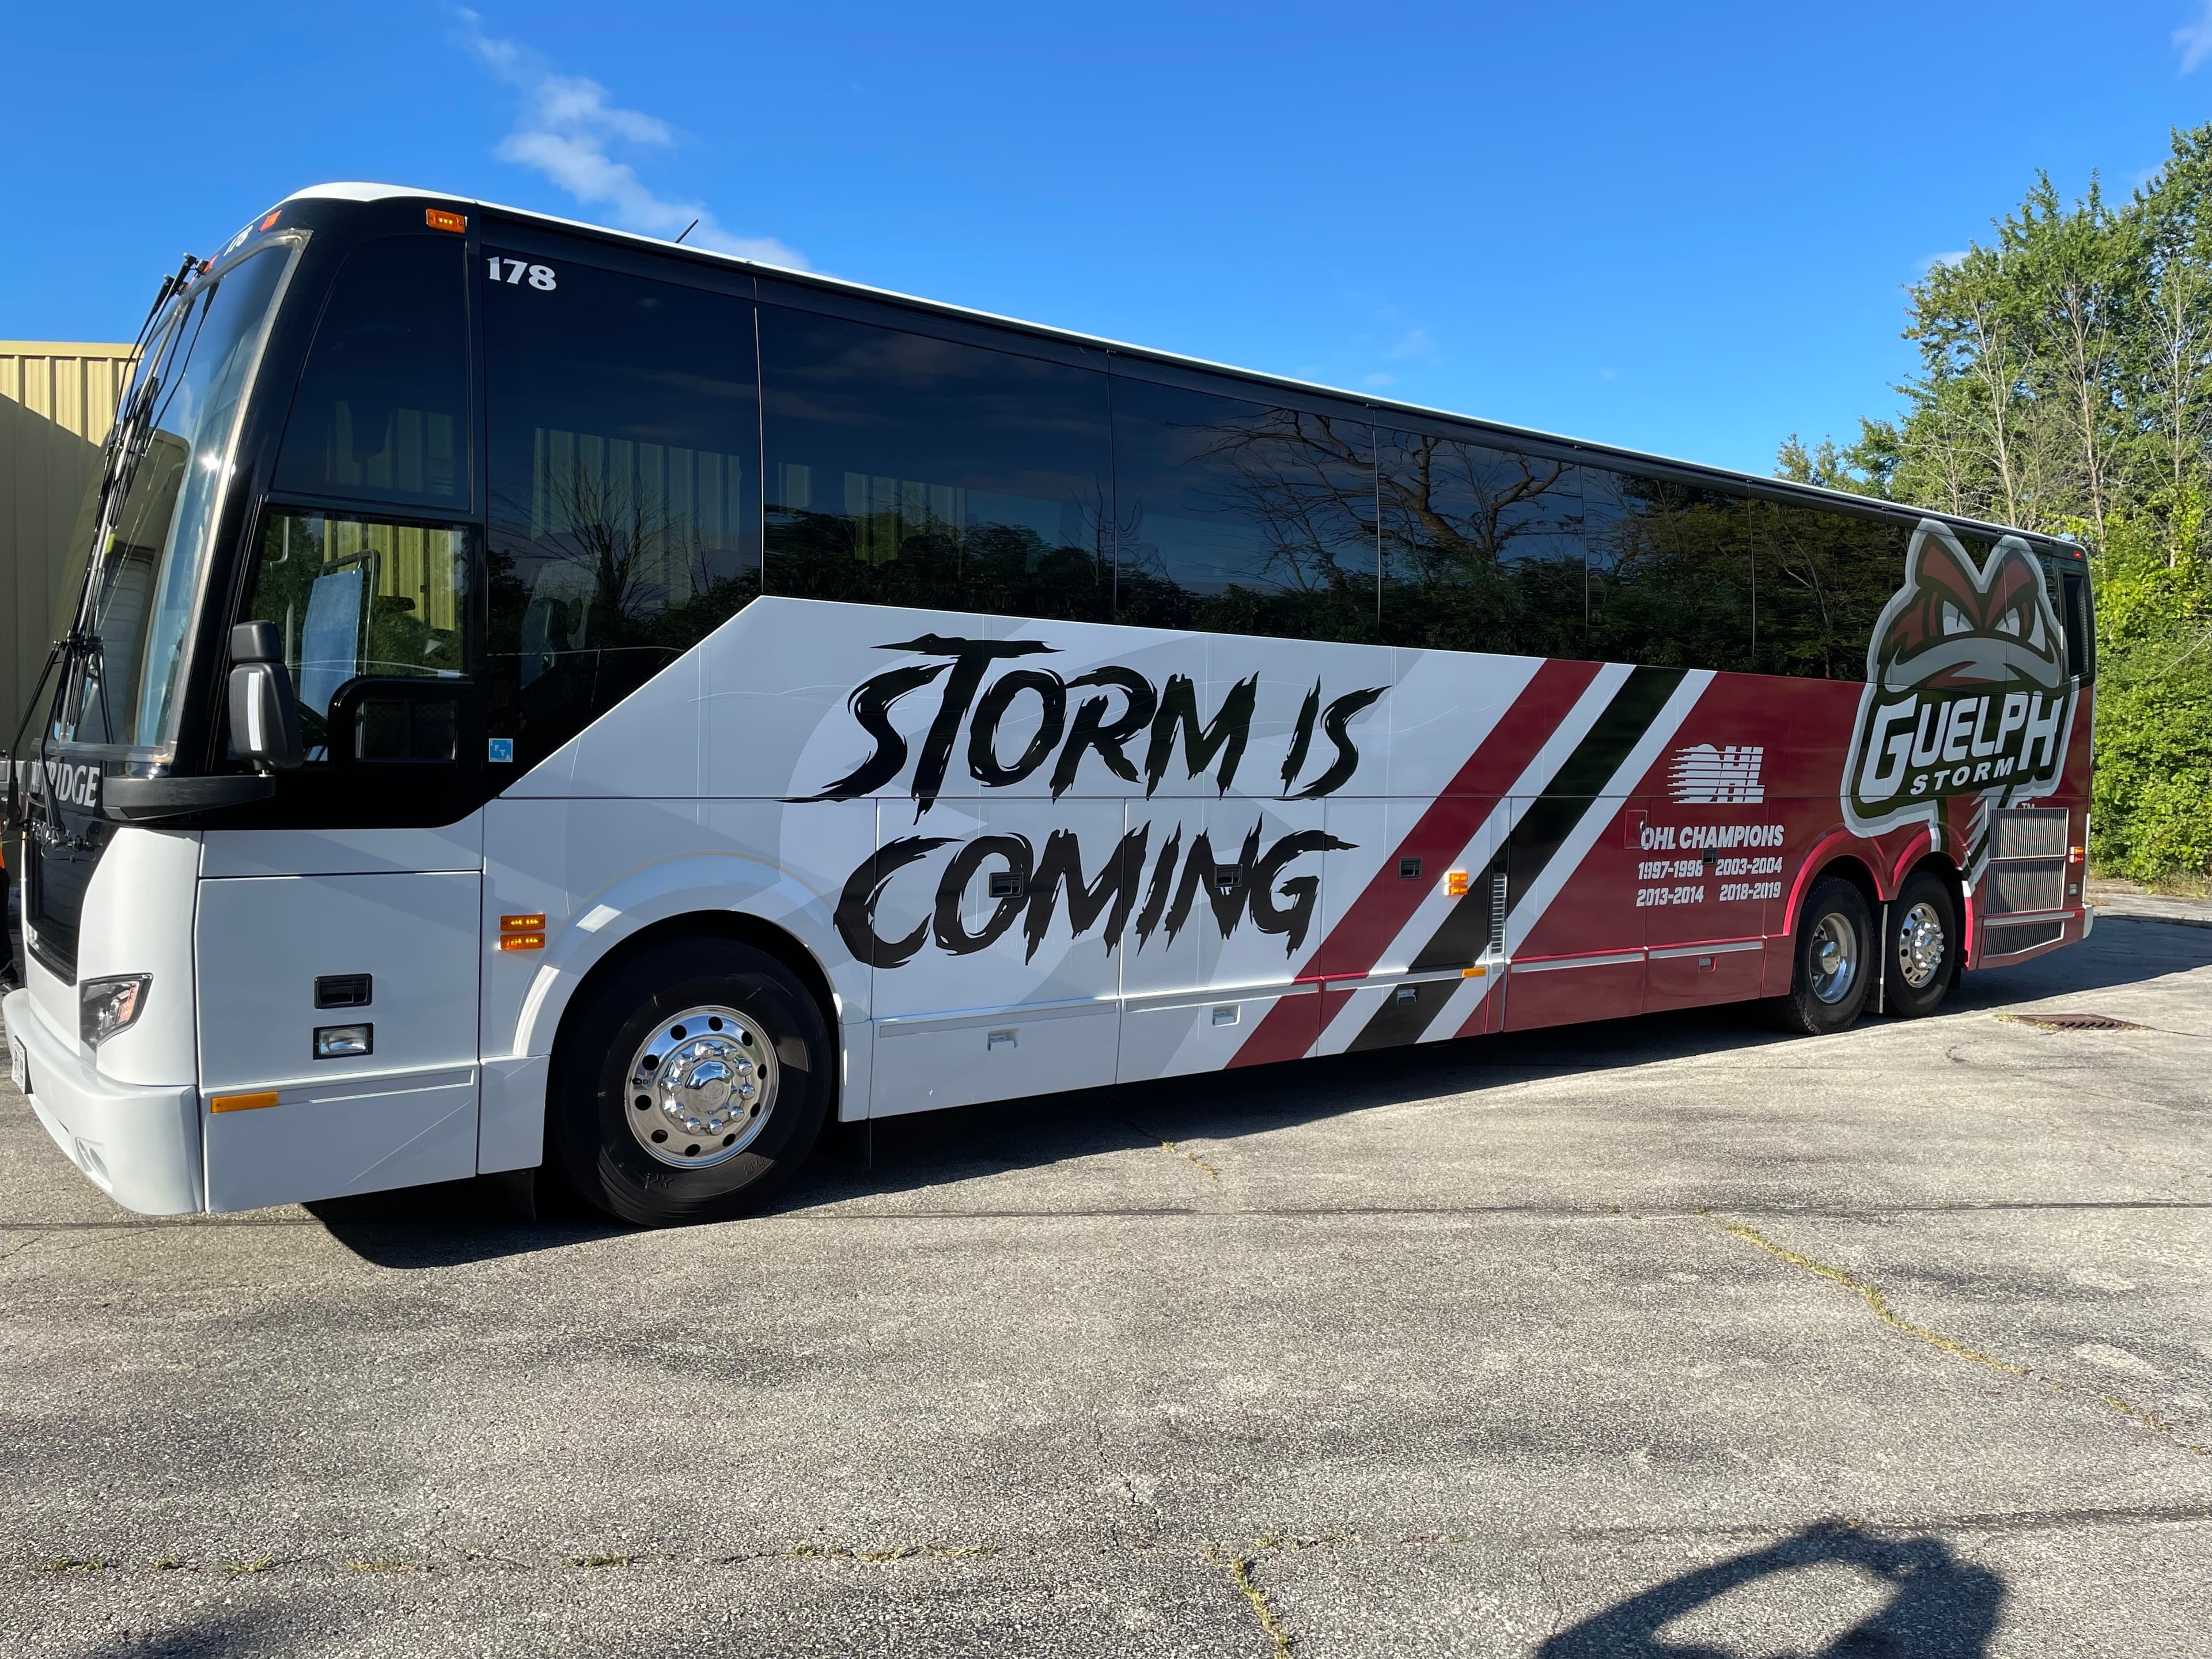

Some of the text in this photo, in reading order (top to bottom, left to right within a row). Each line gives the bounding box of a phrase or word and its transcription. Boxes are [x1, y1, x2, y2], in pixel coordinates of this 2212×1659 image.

[487, 256, 556, 290] 178
[774, 633, 1392, 825] STORM IS
[1858, 691, 2064, 804] GUELPH
[1667, 743, 1766, 804] OHL
[1910, 756, 2015, 795] STORM
[1641, 825, 1785, 850] OHL CHAMPIONS
[1638, 857, 1783, 880] 1997-1998 2003-2004
[832, 813, 1359, 969] COMING
[1636, 881, 1782, 907] 2013-2014 2018-2019
